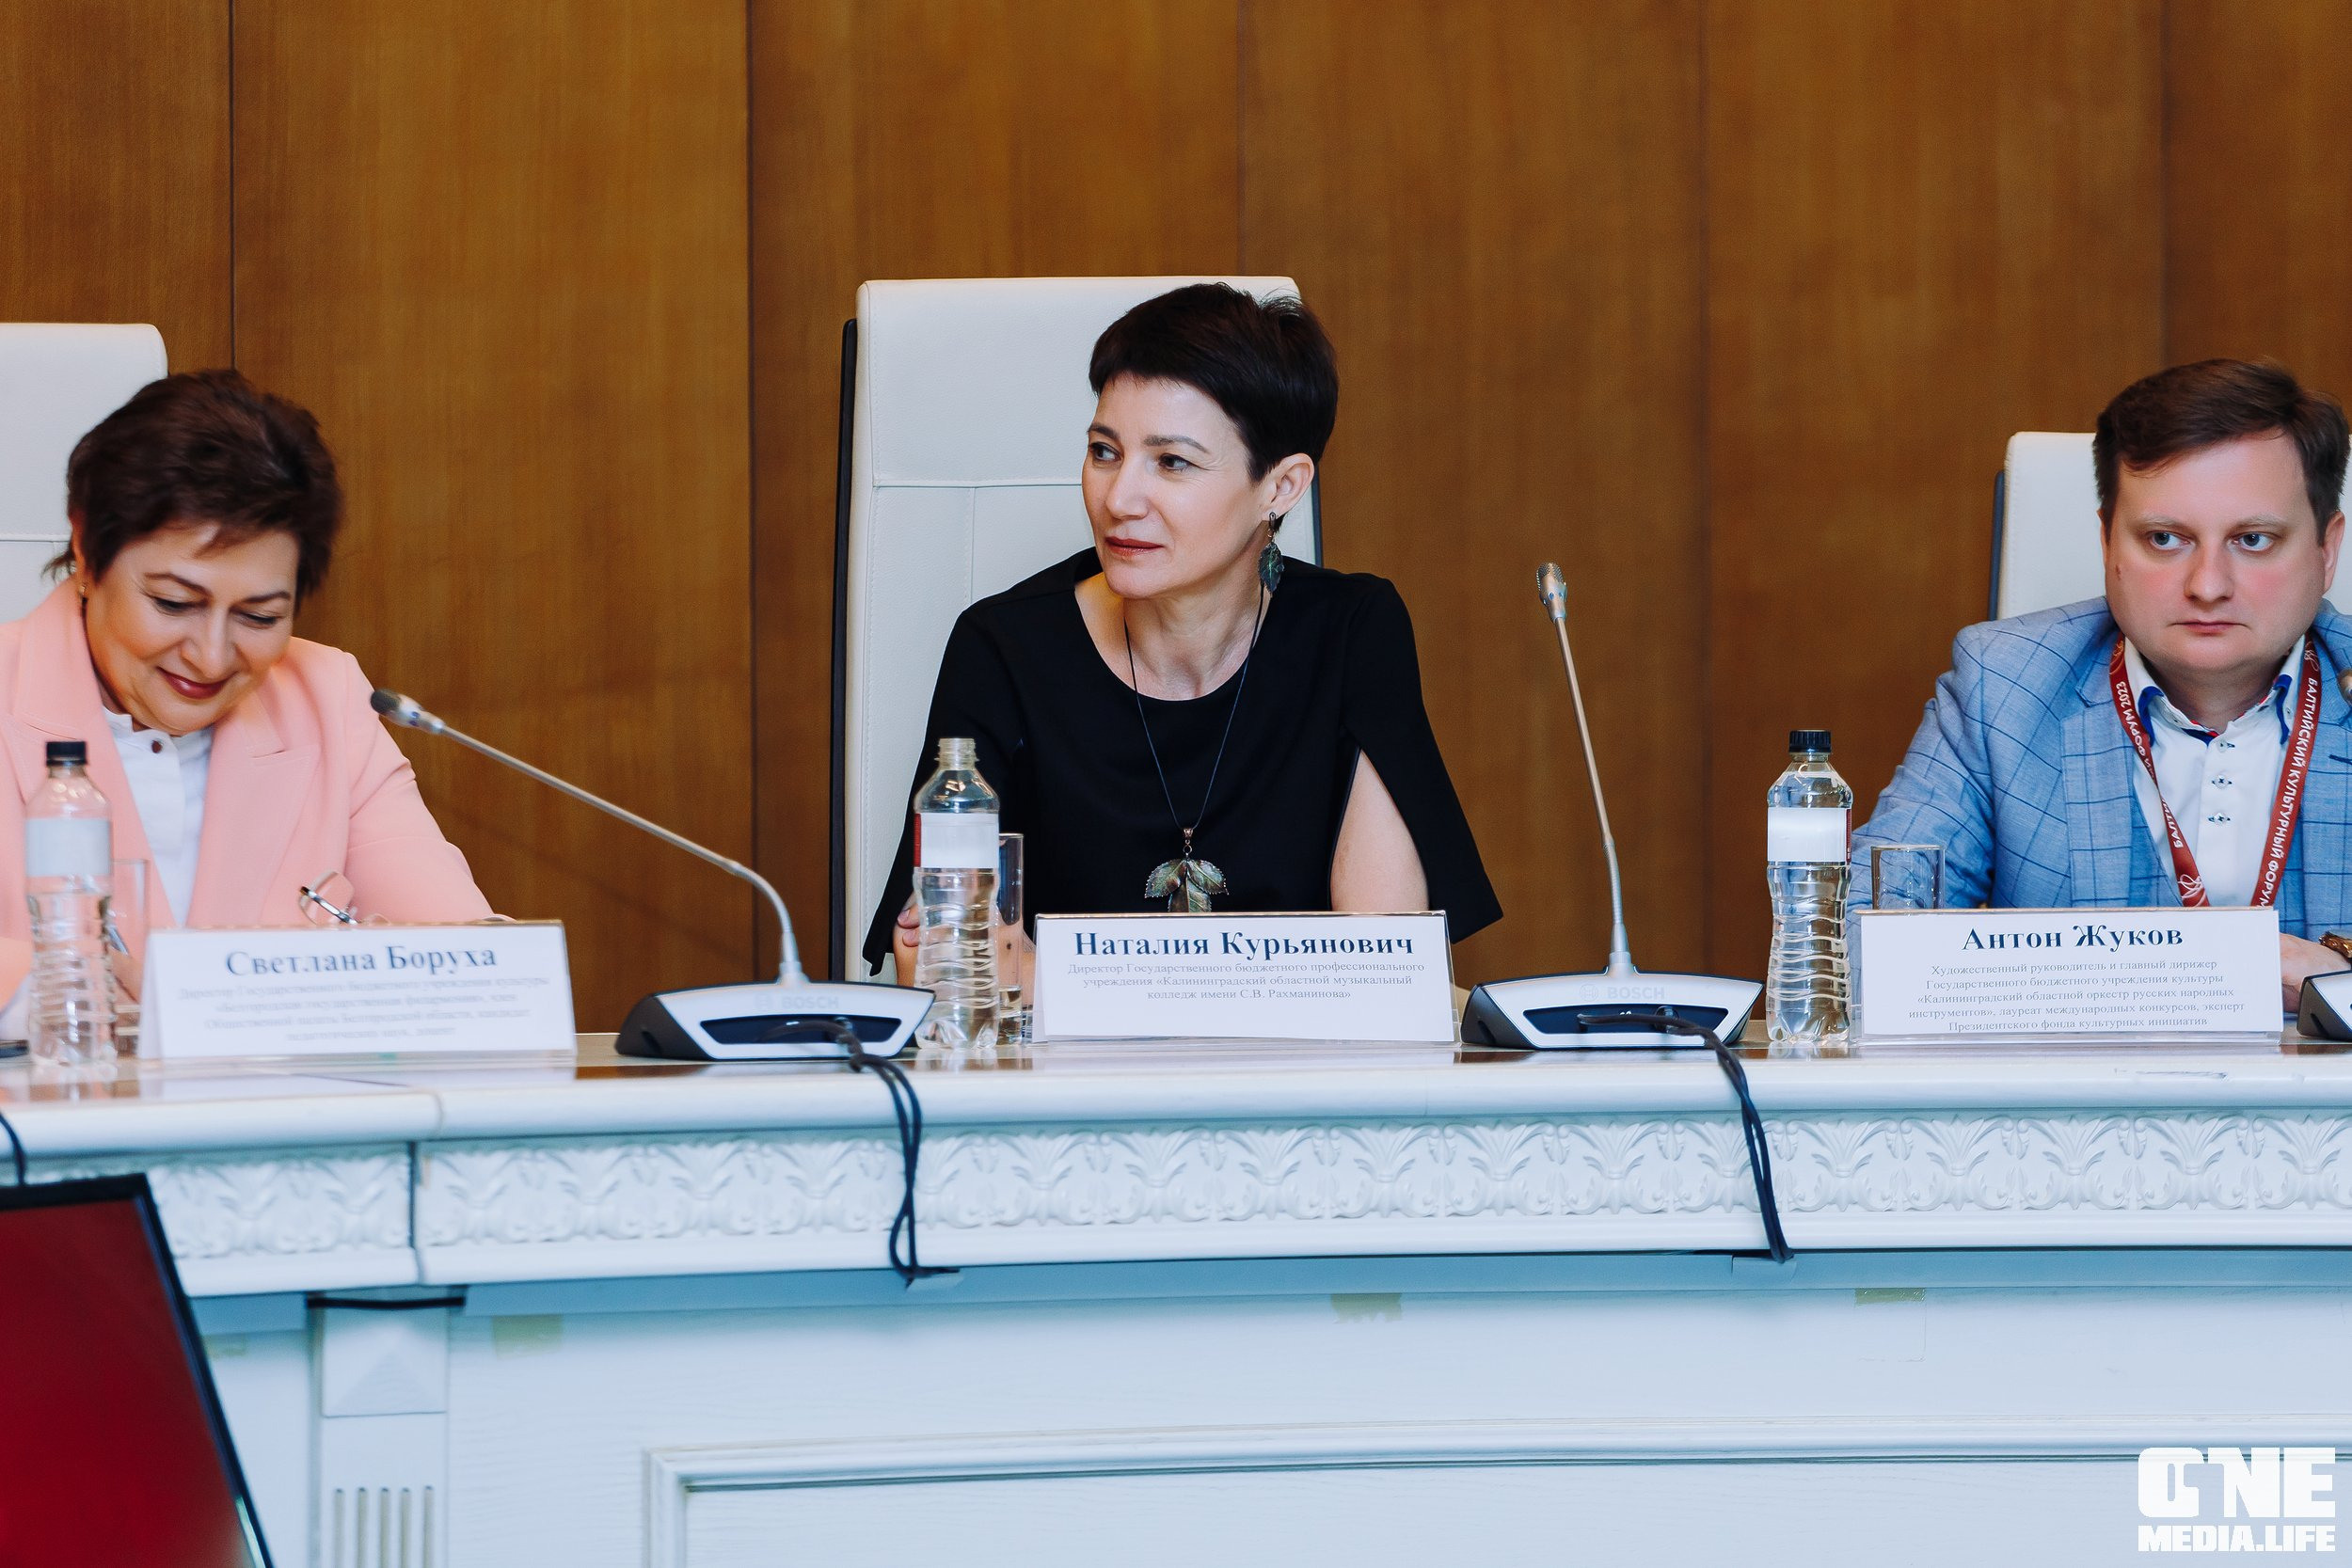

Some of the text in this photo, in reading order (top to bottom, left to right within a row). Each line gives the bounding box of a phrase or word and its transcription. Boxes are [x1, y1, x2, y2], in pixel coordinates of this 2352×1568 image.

[2116, 681, 2131, 708] 2023
[2291, 676, 2318, 768] БАЛТИЙСКИЙ
[2122, 709, 2146, 757] ФОРУМ
[2270, 768, 2301, 859] КУЛЬТУРНЫЙ
[1074, 931, 1415, 960] Наталия Курьянович
[1962, 925, 2184, 952] Антон Жуков
[225, 944, 497, 976] Светлана Боруха
[1931, 964, 2027, 976] Художественный
[2030, 963, 2106, 974] руководитель
[2120, 960, 2167, 970] главный
[2169, 960, 2217, 972] дирижер
[1068, 962, 1425, 975] Директор Государственного бюджетного профессионального
[1083, 975, 1413, 989] учреждения «Калининградский областной музыкальный
[1926, 974, 2223, 990] Государственного бюджетного учреждения культуры
[1147, 989, 1351, 1000] колледж имени С.В. Рахманинова»
[1607, 986, 1665, 1001] BOSCH
[1917, 989, 2234, 1005] «Калининградский областной оркестр русских народных
[780, 995, 840, 1010] BOSCH
[1999, 1007, 2042, 1018] лауреат
[2045, 1006, 2136, 1017] международных
[1948, 1018, 2208, 1033] Президентского фонда культурных инициатив
